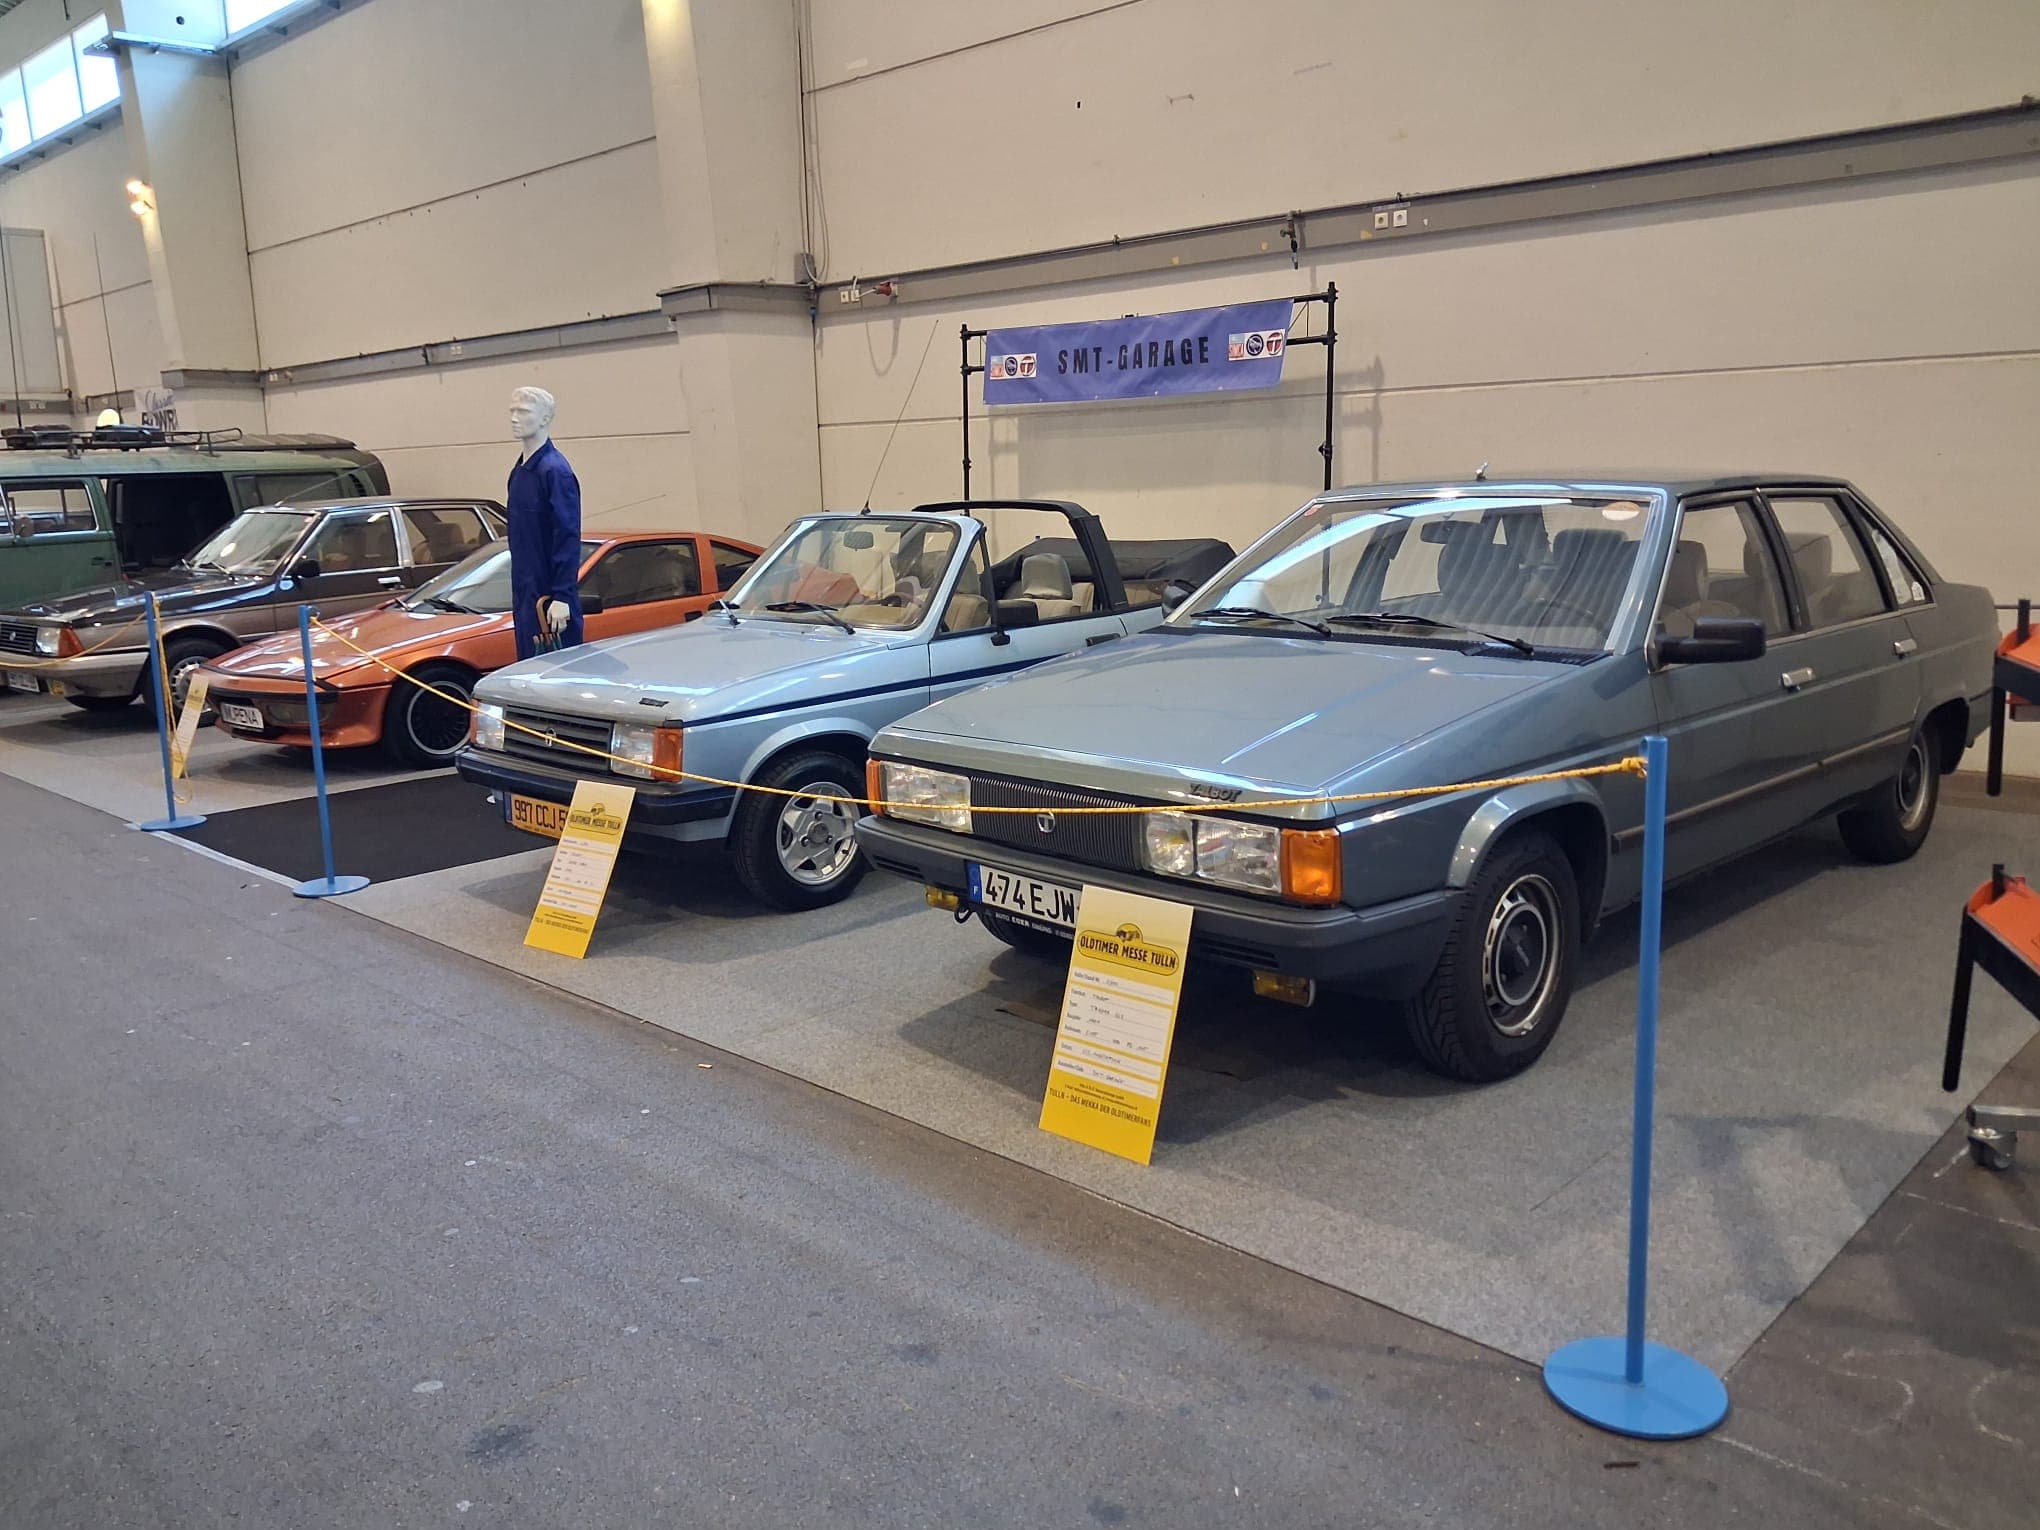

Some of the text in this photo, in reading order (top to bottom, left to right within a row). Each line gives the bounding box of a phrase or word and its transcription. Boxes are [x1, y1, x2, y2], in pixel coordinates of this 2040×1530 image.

[1058, 336, 1209, 375] SMT-GARAGE
[1191, 783, 1242, 802] TALBOT
[514, 799, 533, 824] 997
[535, 804, 556, 829] CCJ
[558, 808, 569, 832] 5
[973, 885, 979, 896] F
[1080, 935, 1176, 969] OLDTIMER MESSE TULLN
[1081, 1097, 1099, 1110] MEKKA
[1099, 1103, 1110, 1114] DER
